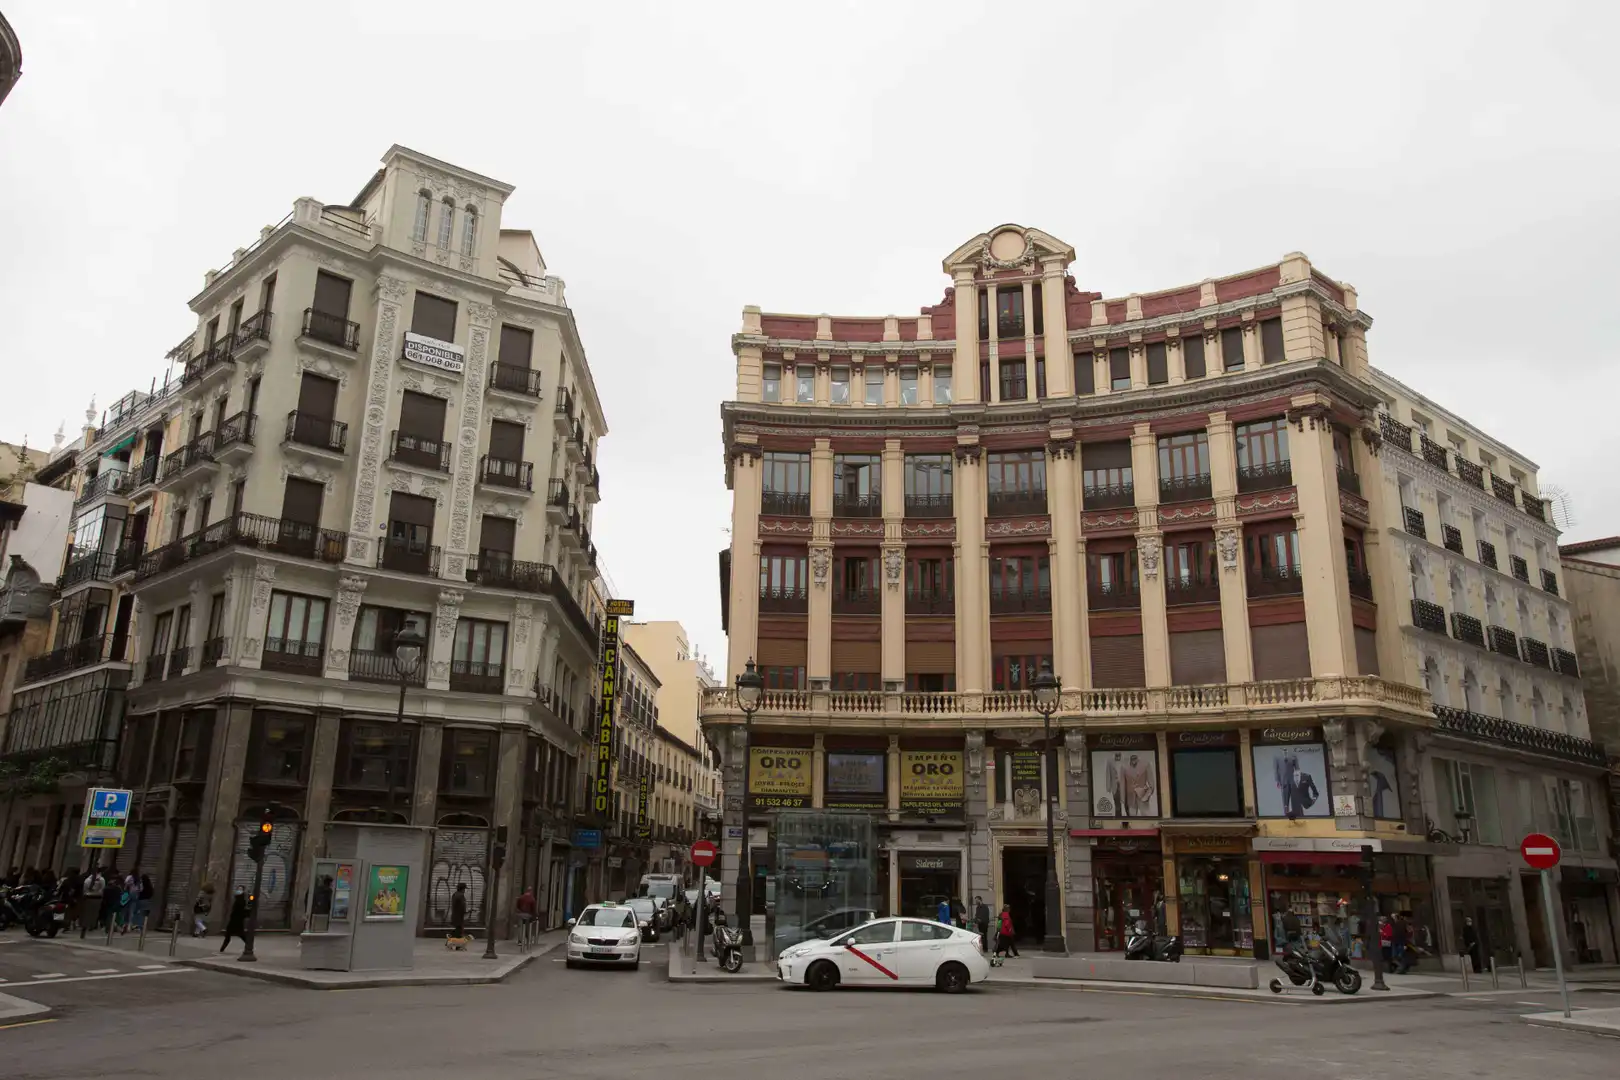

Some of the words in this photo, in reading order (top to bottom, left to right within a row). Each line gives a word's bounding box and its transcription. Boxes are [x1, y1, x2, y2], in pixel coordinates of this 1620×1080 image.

[408, 342, 462, 361] DISPONIBLE
[595, 649, 616, 811] CANTABRICO
[1263, 728, 1312, 741] Canalejas
[760, 756, 802, 769] ORO
[912, 763, 954, 775] ORO
[104, 793, 118, 808] P
[755, 798, 765, 806] 91
[766, 798, 781, 806] 532
[782, 799, 792, 807] 46
[793, 799, 803, 807] 37
